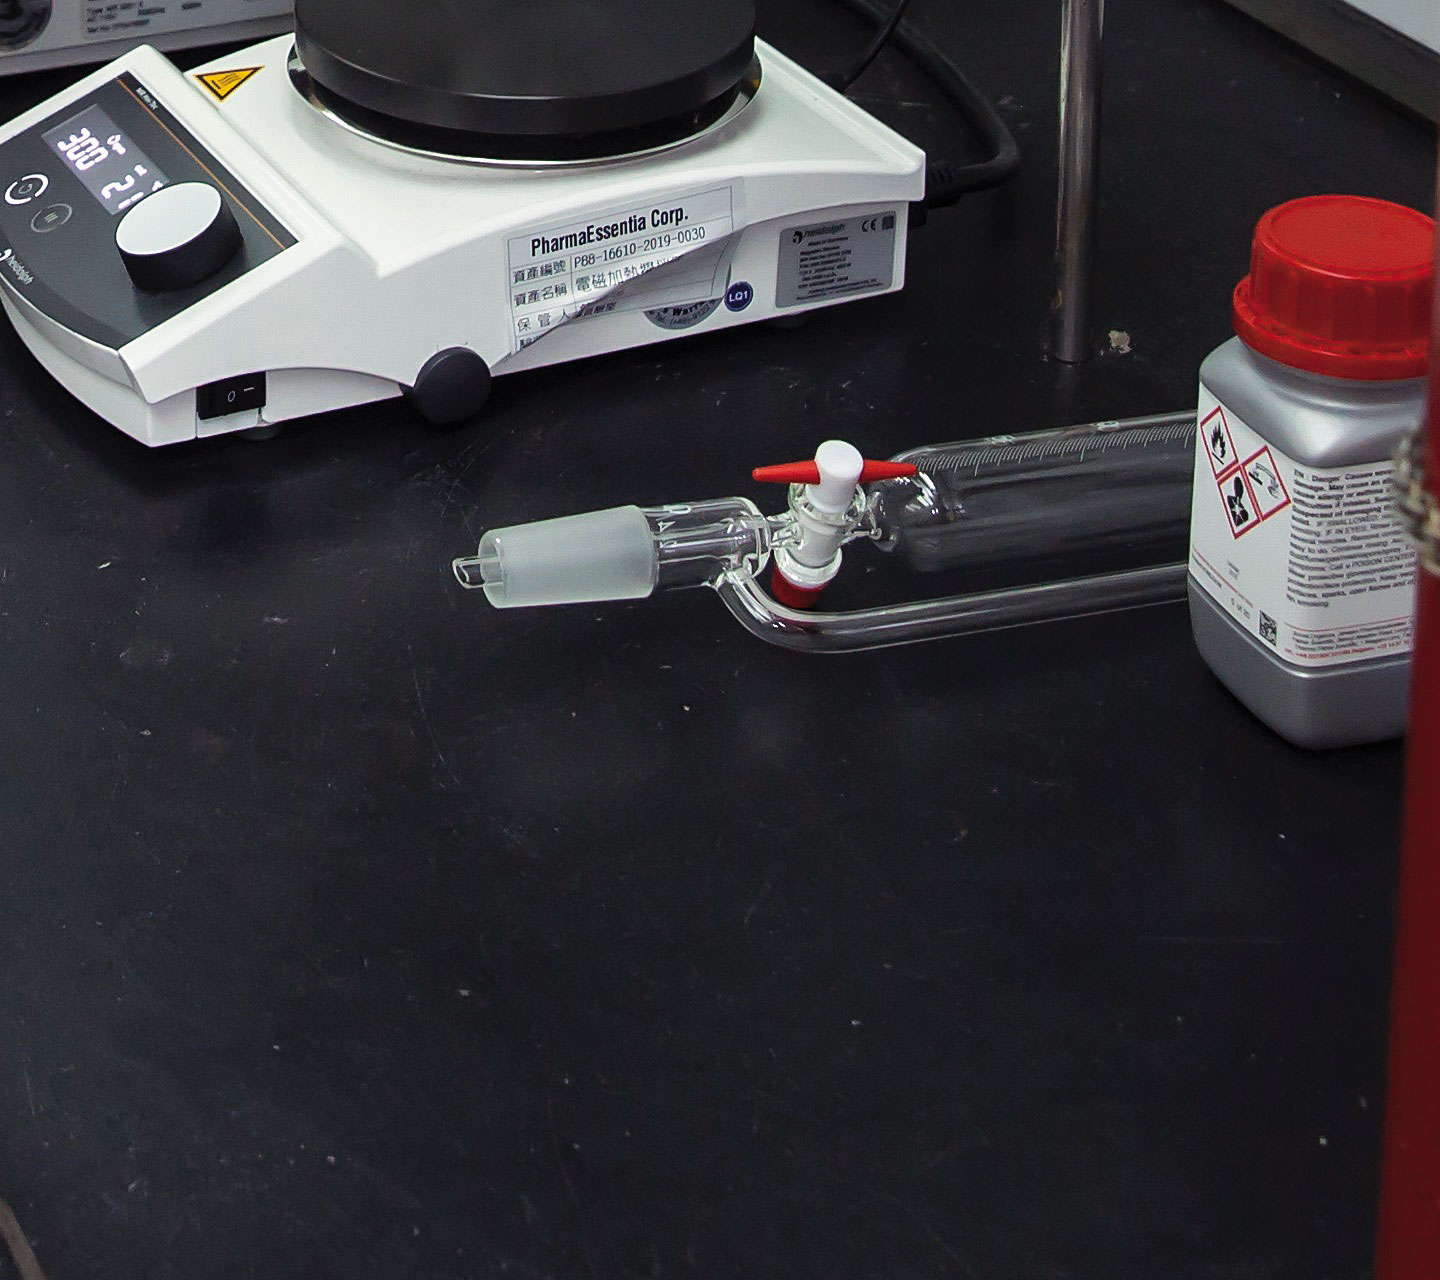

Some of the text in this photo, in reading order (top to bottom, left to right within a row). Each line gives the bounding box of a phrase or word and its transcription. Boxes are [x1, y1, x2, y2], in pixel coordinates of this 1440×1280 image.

[57, 127, 109, 171] 300
[531, 207, 689, 257] PharmaEssentia Corp.
[574, 226, 706, 269] P88-16610-2019-0030
[728, 290, 748, 303] LQ1
